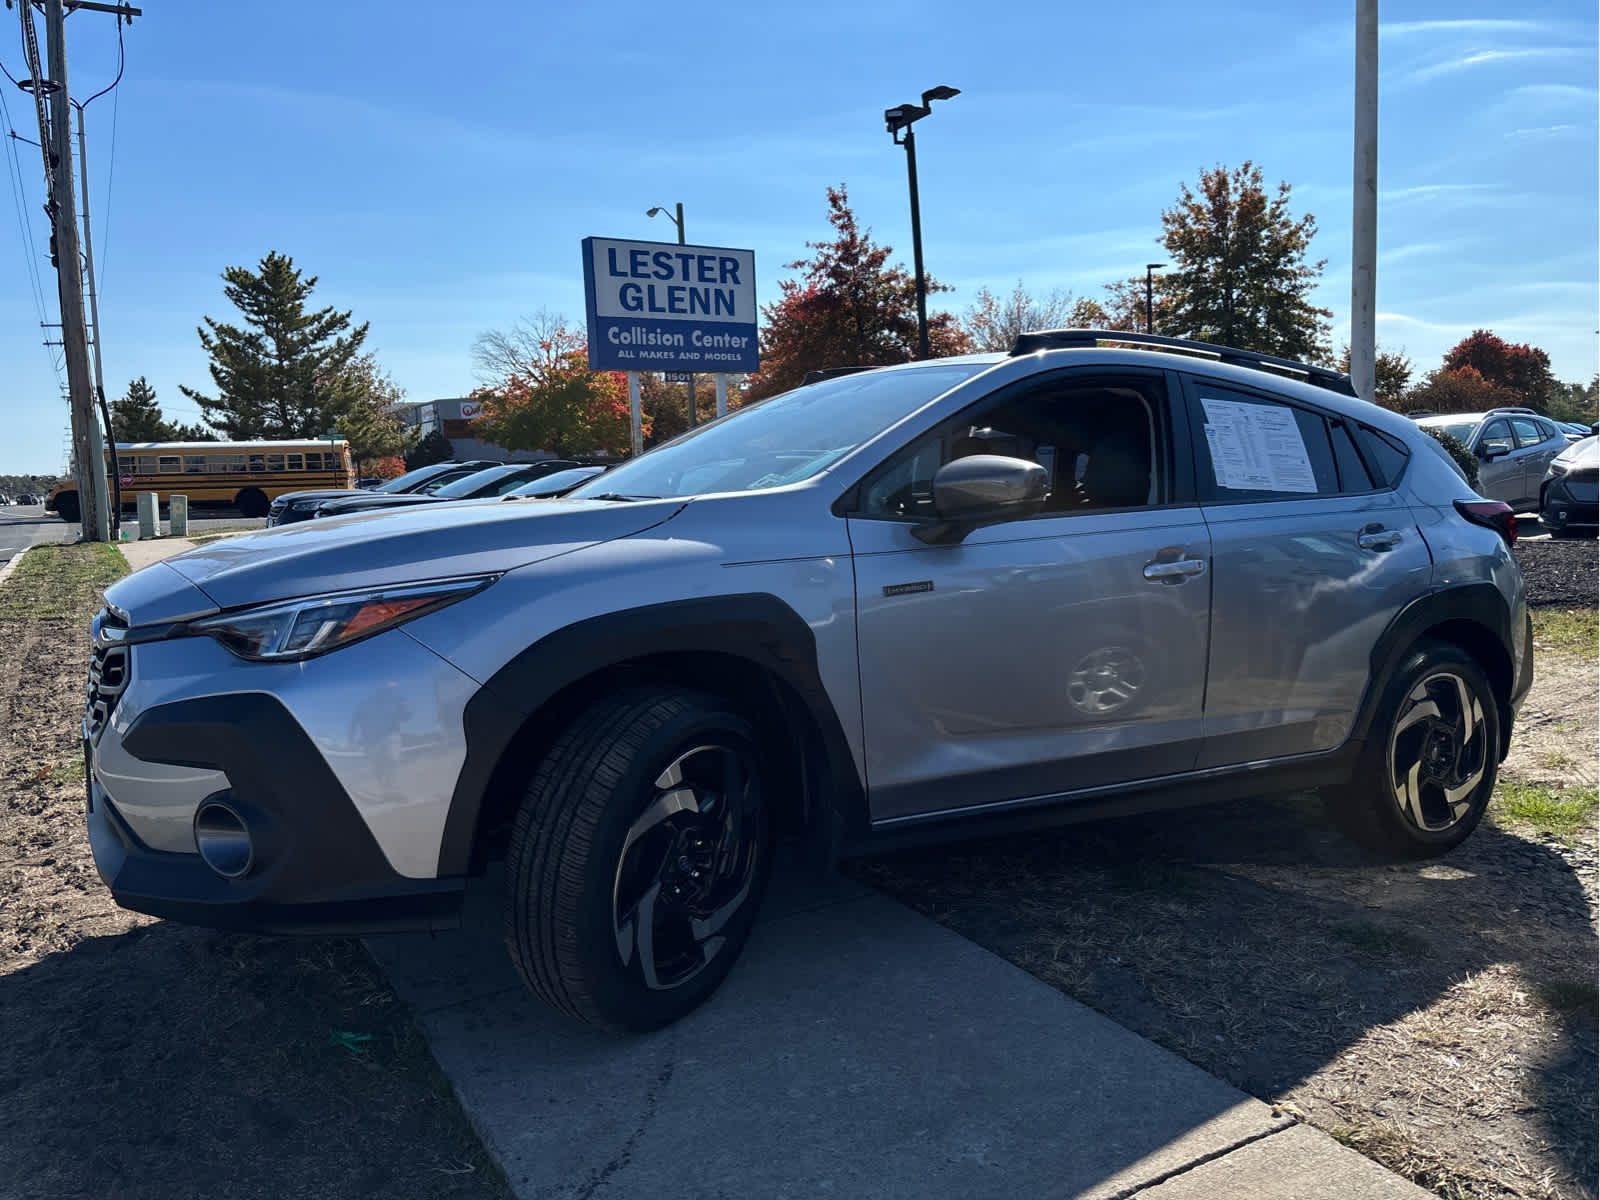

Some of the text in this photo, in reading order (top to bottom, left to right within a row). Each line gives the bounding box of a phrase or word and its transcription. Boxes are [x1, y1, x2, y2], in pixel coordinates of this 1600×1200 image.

[607, 248, 741, 285] LESTER
[619, 282, 735, 316] GLENN
[608, 326, 748, 349] Collision Center
[618, 350, 742, 361] ALL MAKES AND MODELS
